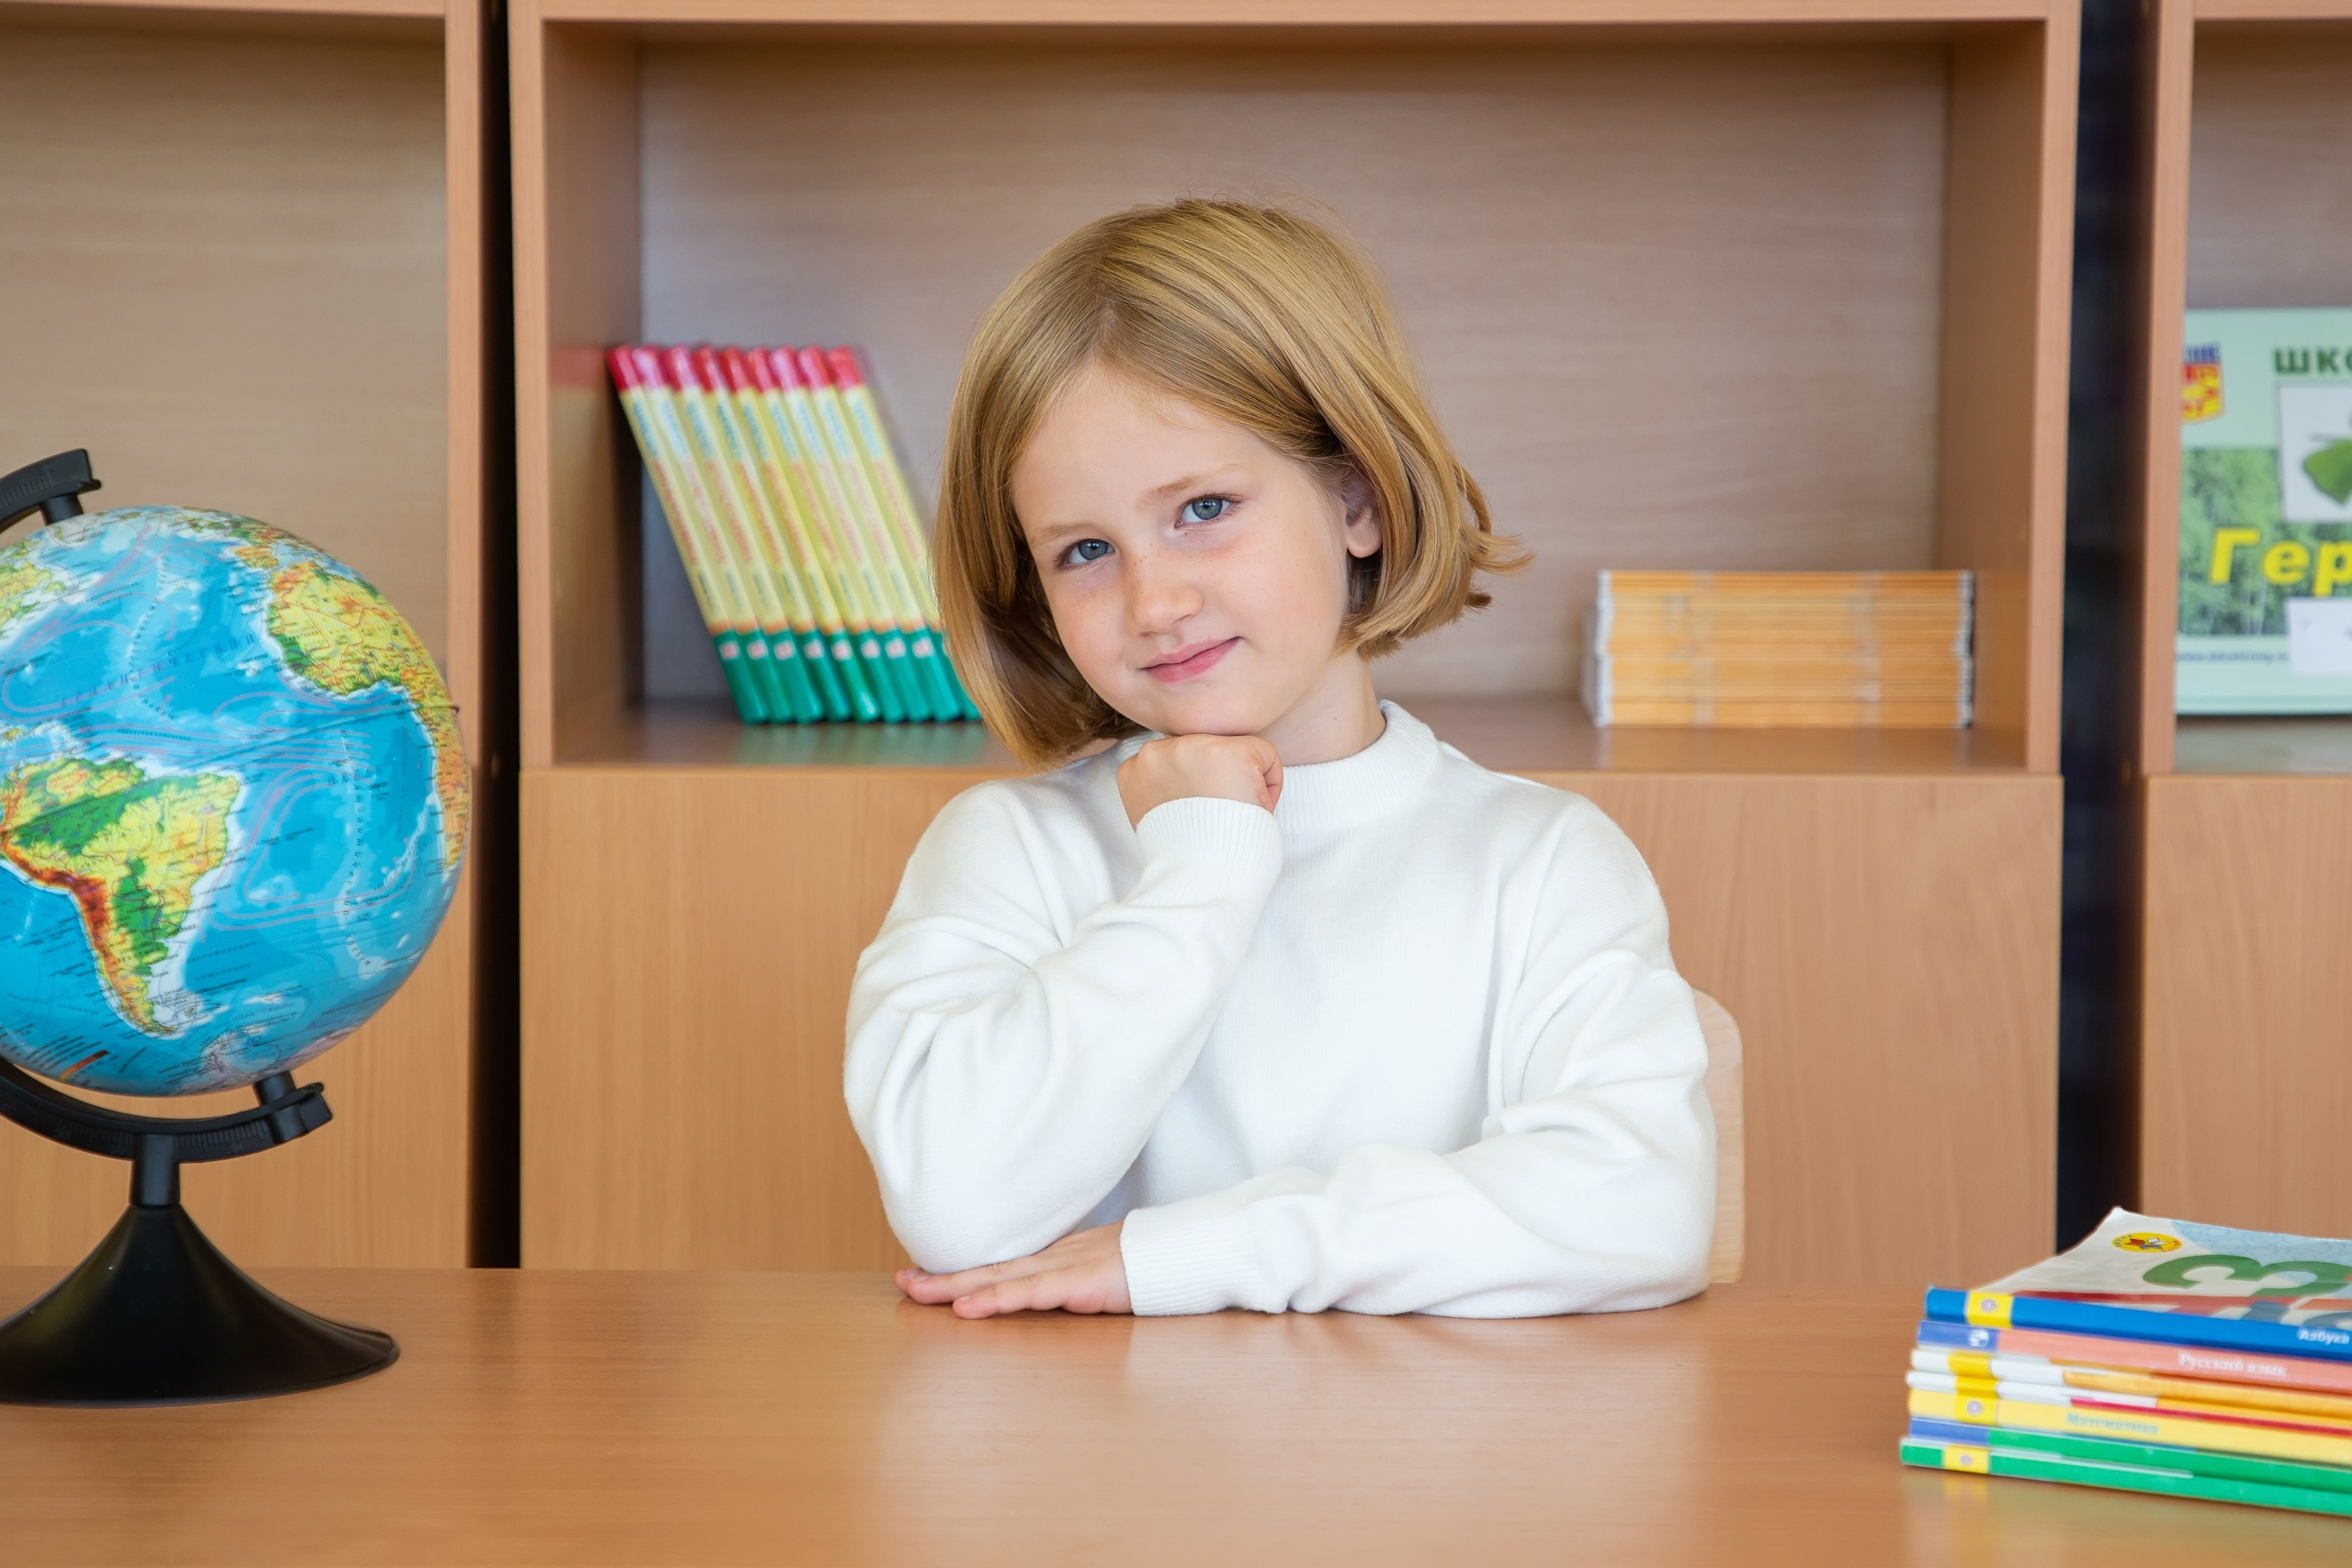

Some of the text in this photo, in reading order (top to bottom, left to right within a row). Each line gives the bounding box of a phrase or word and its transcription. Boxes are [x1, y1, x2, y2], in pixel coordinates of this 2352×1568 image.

[2209, 526, 2352, 599] Гер
[2178, 1351, 2244, 1371] Русский
[2066, 1412, 2160, 1435] Математика
